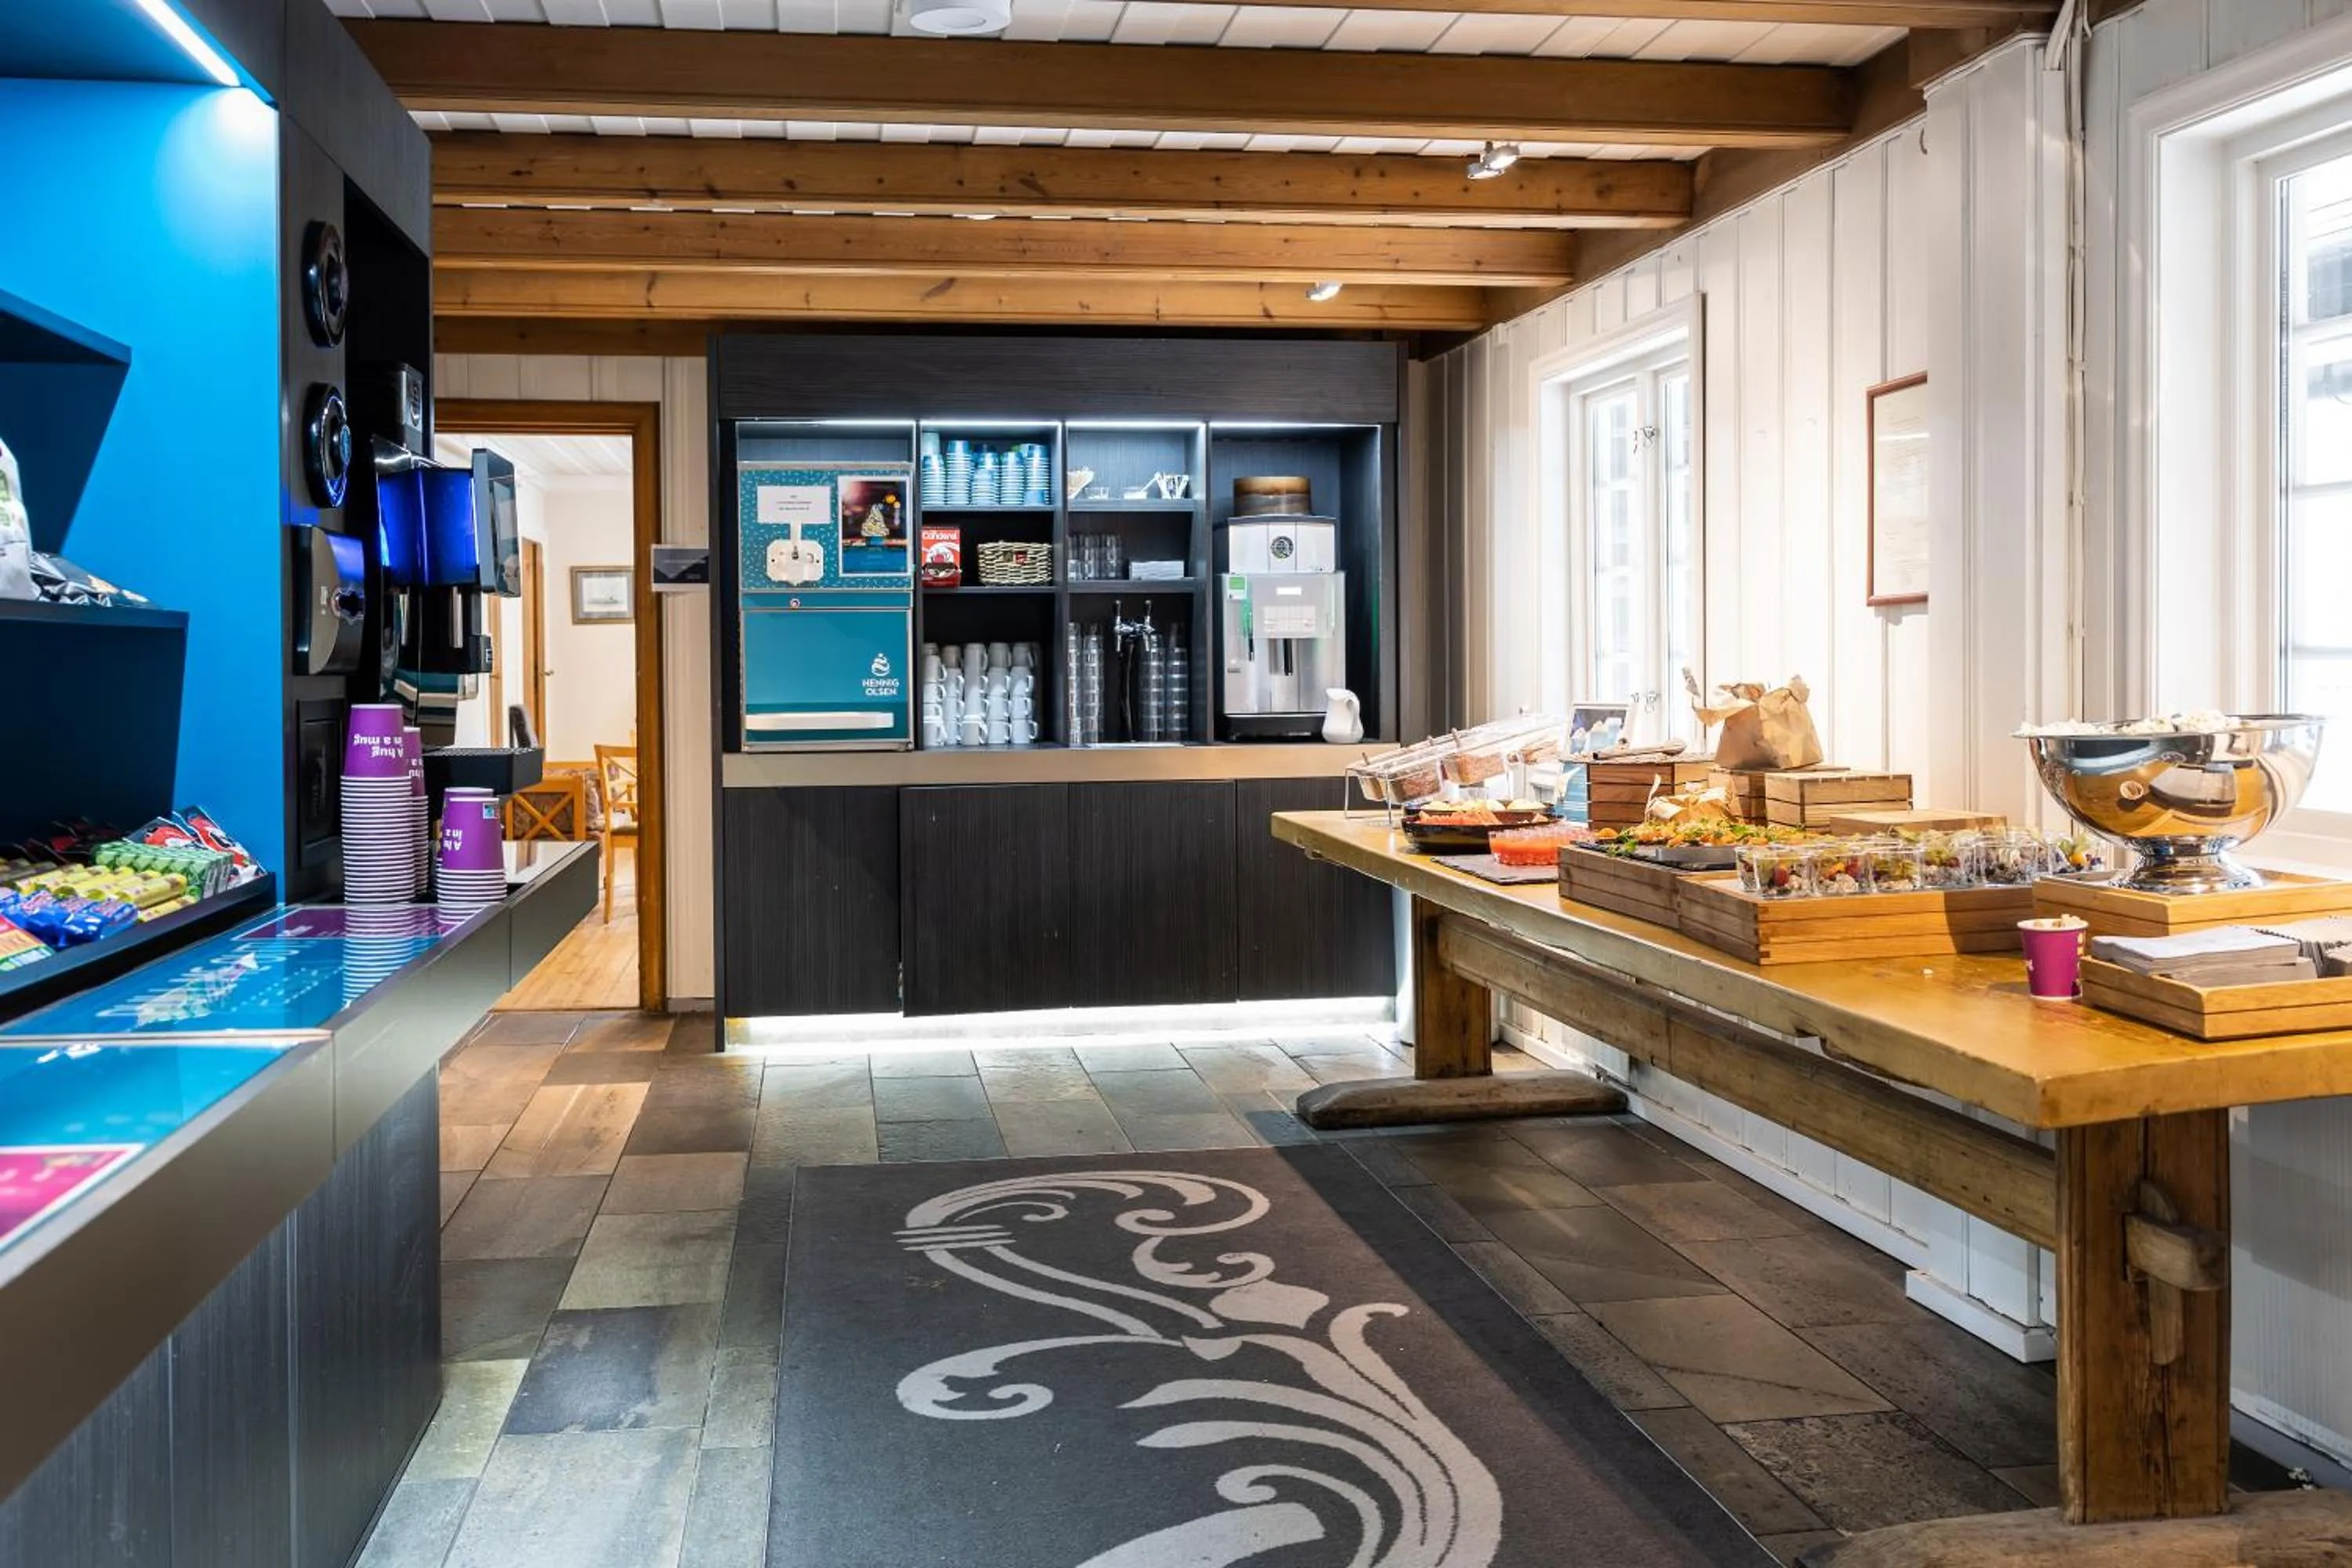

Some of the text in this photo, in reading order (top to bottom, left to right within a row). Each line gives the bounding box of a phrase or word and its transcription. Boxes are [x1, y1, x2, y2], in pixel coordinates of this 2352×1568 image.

[862, 679, 899, 688] HENNIG
[866, 688, 898, 697] OLSEN
[354, 734, 380, 746] mug
[372, 746, 404, 758] A hug
[452, 829, 463, 840] in
[454, 840, 462, 851] A
